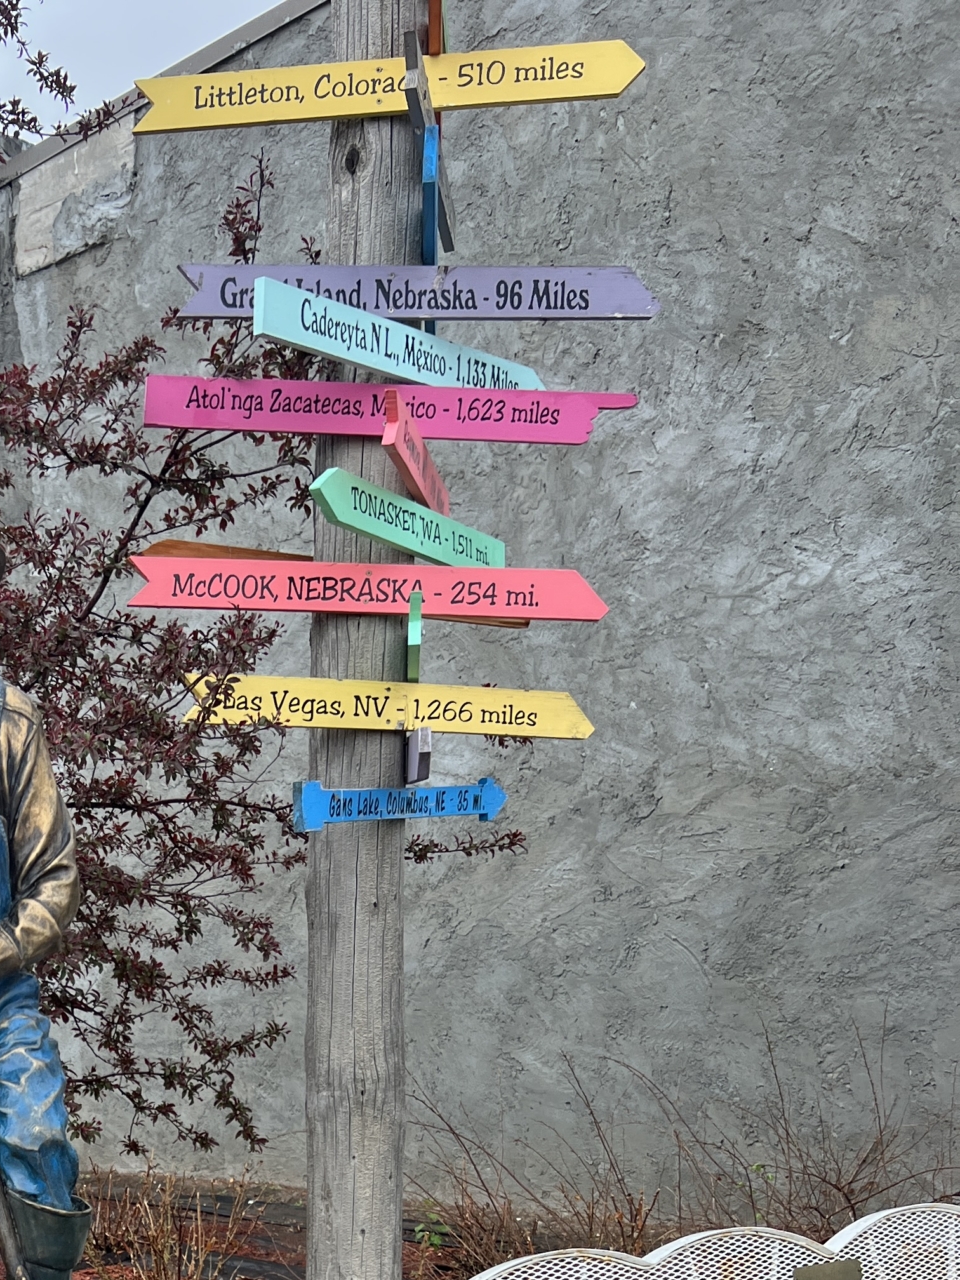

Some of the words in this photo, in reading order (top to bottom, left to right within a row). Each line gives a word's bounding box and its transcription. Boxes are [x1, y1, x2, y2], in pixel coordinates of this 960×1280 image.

[194, 82, 305, 110] Littleton,
[314, 73, 428, 99] Colora
[457, 60, 506, 87] 510
[514, 57, 584, 83] miles
[374, 279, 478, 311] Nebraska
[495, 279, 523, 310] 96
[528, 279, 590, 310] Miles
[301, 298, 367, 352] Cadereyta
[371, 322, 381, 355] N
[456, 354, 487, 388] 1,133
[269, 388, 364, 418] Zacatecas,
[371, 394, 436, 419] Mico
[456, 398, 506, 424] 1,623
[510, 401, 560, 425] miles
[351, 486, 419, 539] TONASKET,
[421, 517, 442, 545] WA
[451, 531, 473, 560] 1,511
[475, 546, 490, 566] mi.
[171, 573, 278, 602] McCOOK,
[286, 576, 425, 603] NEBRASKA
[450, 581, 497, 606] 254
[505, 584, 539, 607] mi.
[270, 690, 345, 722] Vegas,
[353, 695, 390, 718] NV
[413, 699, 473, 723] 1,266
[480, 704, 537, 726] miles
[357, 791, 383, 818] Lake,
[386, 790, 432, 816] Columbus,
[435, 789, 446, 812] NE
[457, 789, 469, 812] 35
[472, 787, 485, 811] mi.
